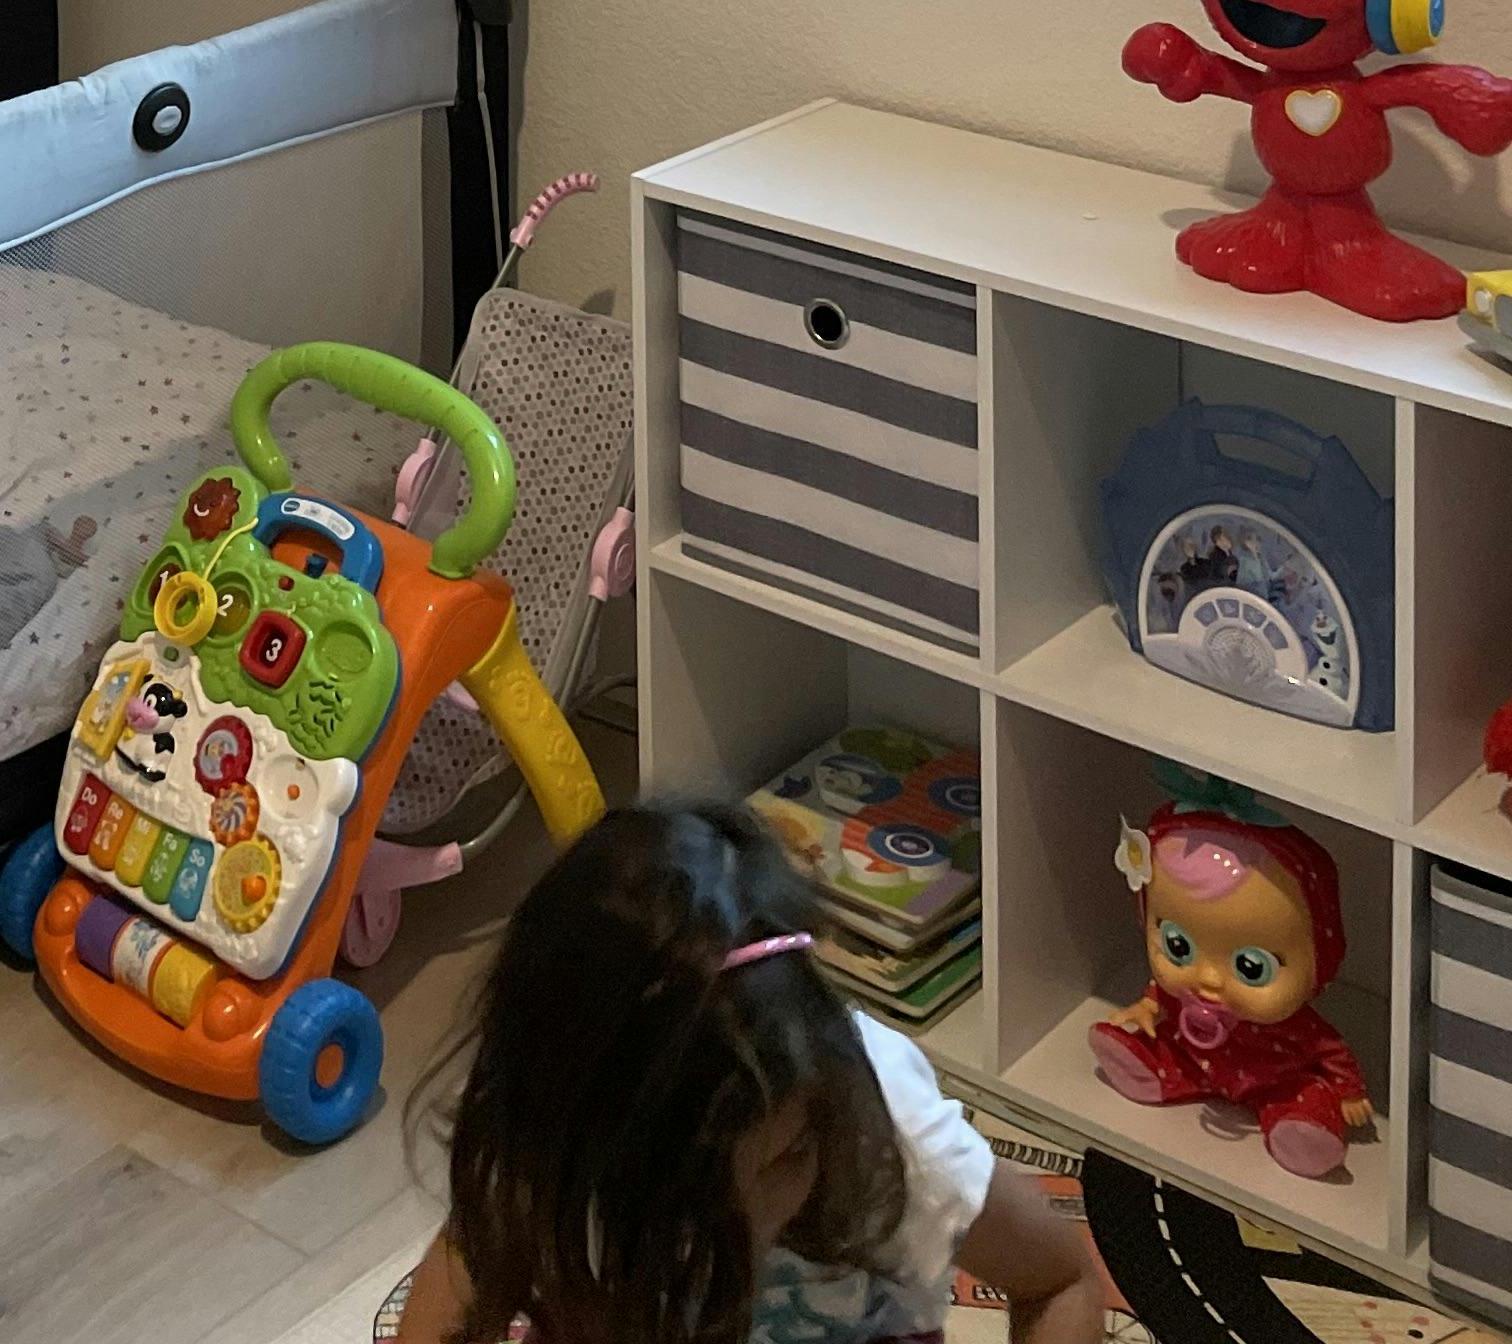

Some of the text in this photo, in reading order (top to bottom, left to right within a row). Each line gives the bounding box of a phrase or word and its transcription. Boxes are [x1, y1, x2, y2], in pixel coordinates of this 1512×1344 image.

[216, 594, 235, 617] 2
[265, 638, 283, 662] 3
[81, 787, 98, 805] Do
[107, 801, 124, 820] Re
[162, 832, 178, 851] Fa
[189, 848, 206, 868] So
